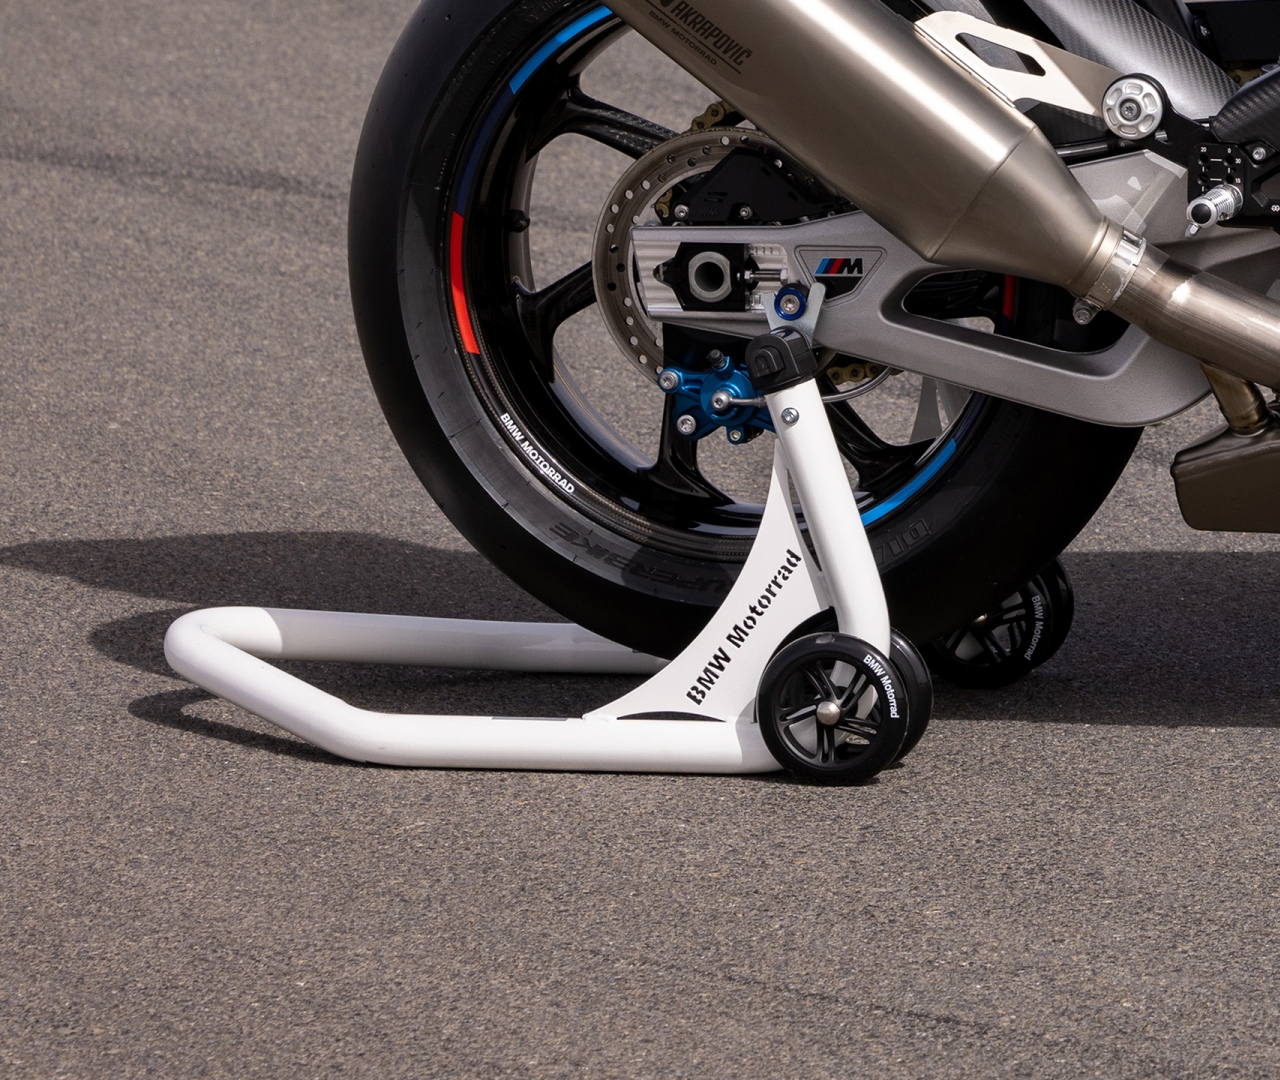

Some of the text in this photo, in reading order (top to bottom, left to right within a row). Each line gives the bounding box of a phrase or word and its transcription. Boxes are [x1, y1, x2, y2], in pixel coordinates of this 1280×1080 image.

[649, 10, 671, 29] BMW
[671, 27, 717, 66] MOTORRAD
[500, 413, 575, 493] BMW MOTORRAD
[549, 520, 728, 594] UPERBIKE
[686, 548, 802, 705] BMW Motorrad
[1023, 594, 1044, 661] BMW Motorrad
[863, 654, 900, 719] BMW Motorrad
